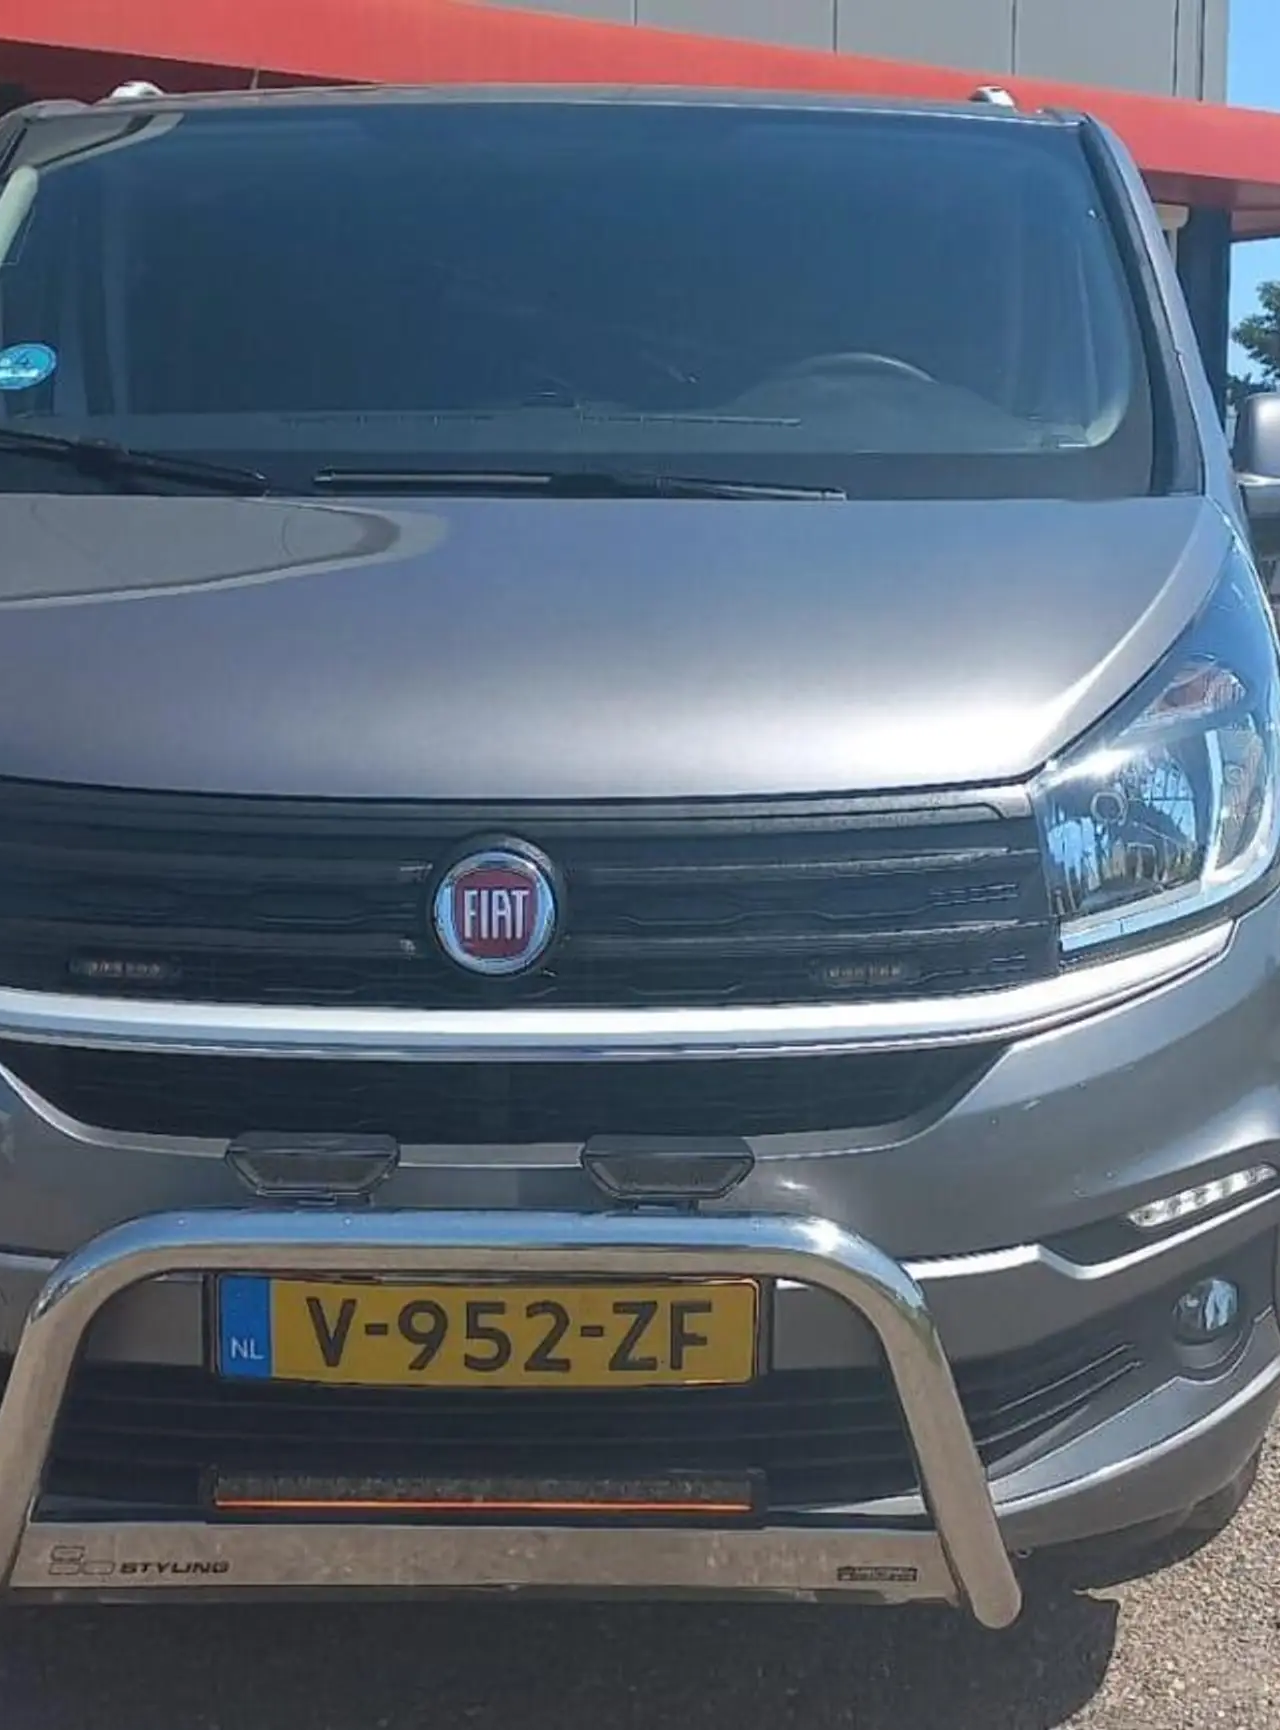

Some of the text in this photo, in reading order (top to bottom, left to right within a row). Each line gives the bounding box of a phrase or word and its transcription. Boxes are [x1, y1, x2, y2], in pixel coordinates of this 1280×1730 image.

[463, 888, 531, 940] FIAT
[230, 1337, 264, 1360] NL
[305, 1296, 713, 1372] V-952-ZF
